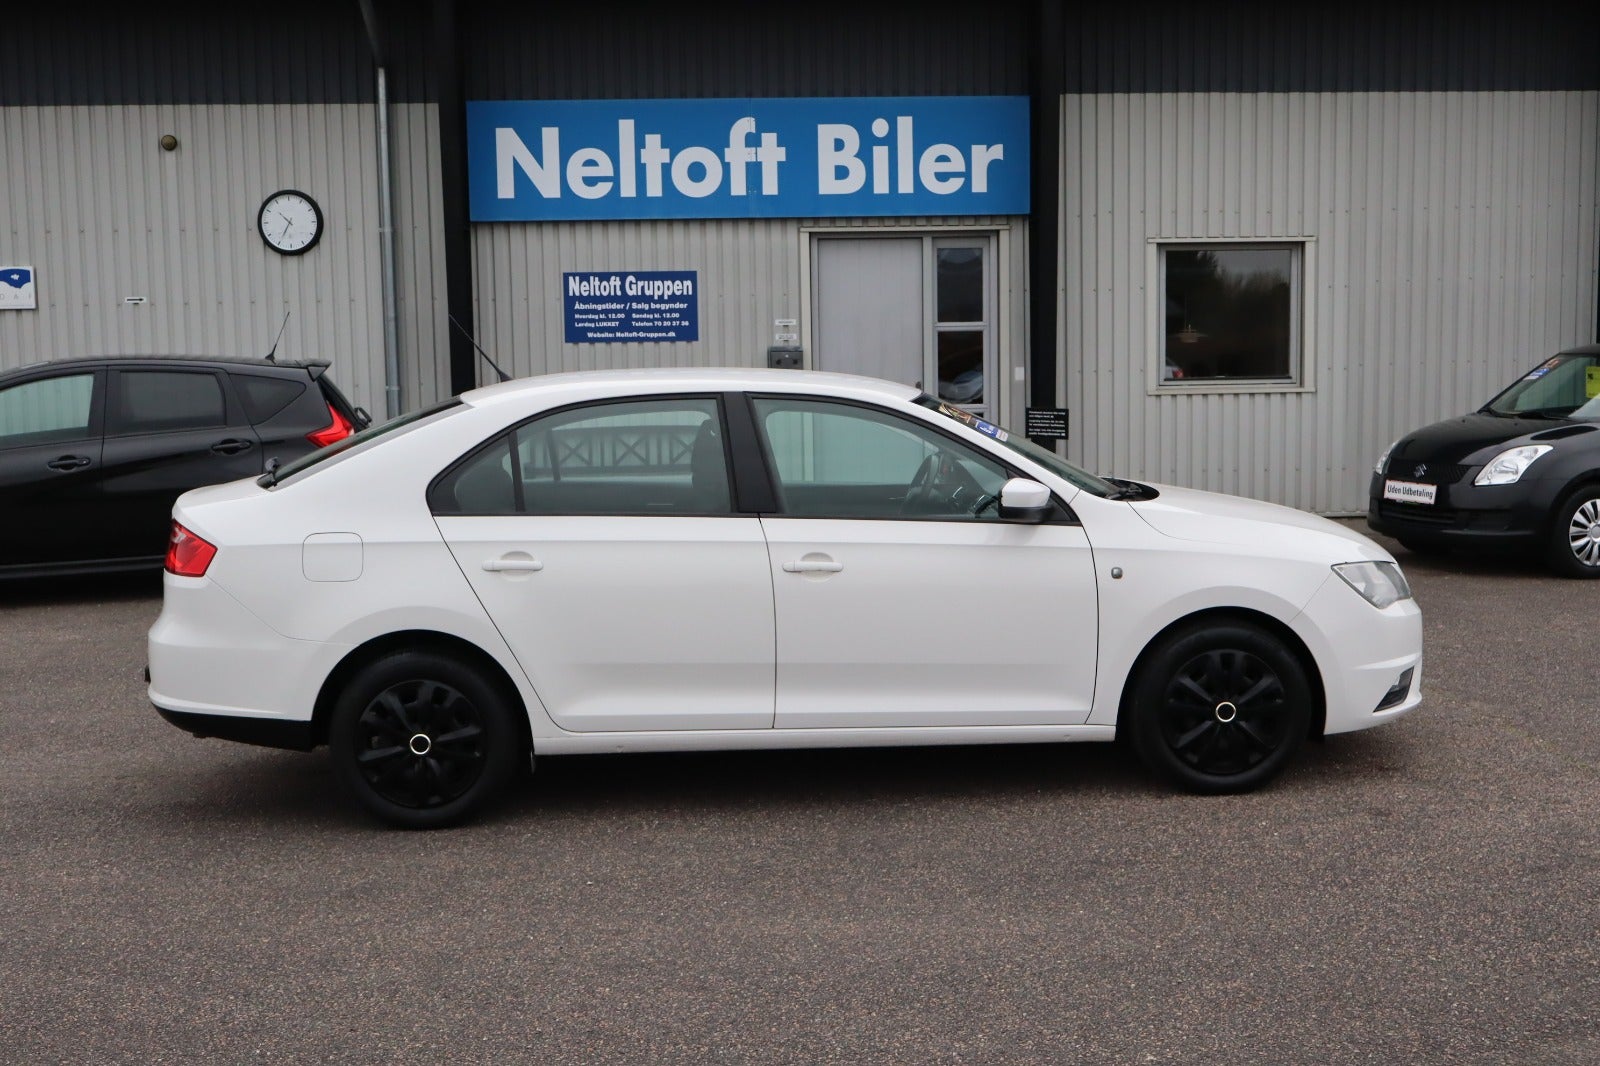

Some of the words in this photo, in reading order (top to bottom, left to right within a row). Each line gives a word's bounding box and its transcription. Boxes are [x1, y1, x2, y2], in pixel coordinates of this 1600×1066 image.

[495, 117, 787, 200] Neltoft
[817, 116, 1005, 196] Biler
[568, 274, 622, 297] Neltoft
[625, 274, 693, 300] Gruppen
[574, 302, 625, 310] Åbningstider
[631, 302, 650, 311] Salg
[651, 302, 688, 310] begynder
[616, 331, 676, 339] Neltoft-Gruppen.dk
[1387, 484, 1401, 494] Uden
[1402, 486, 1434, 500] Udbetaling
